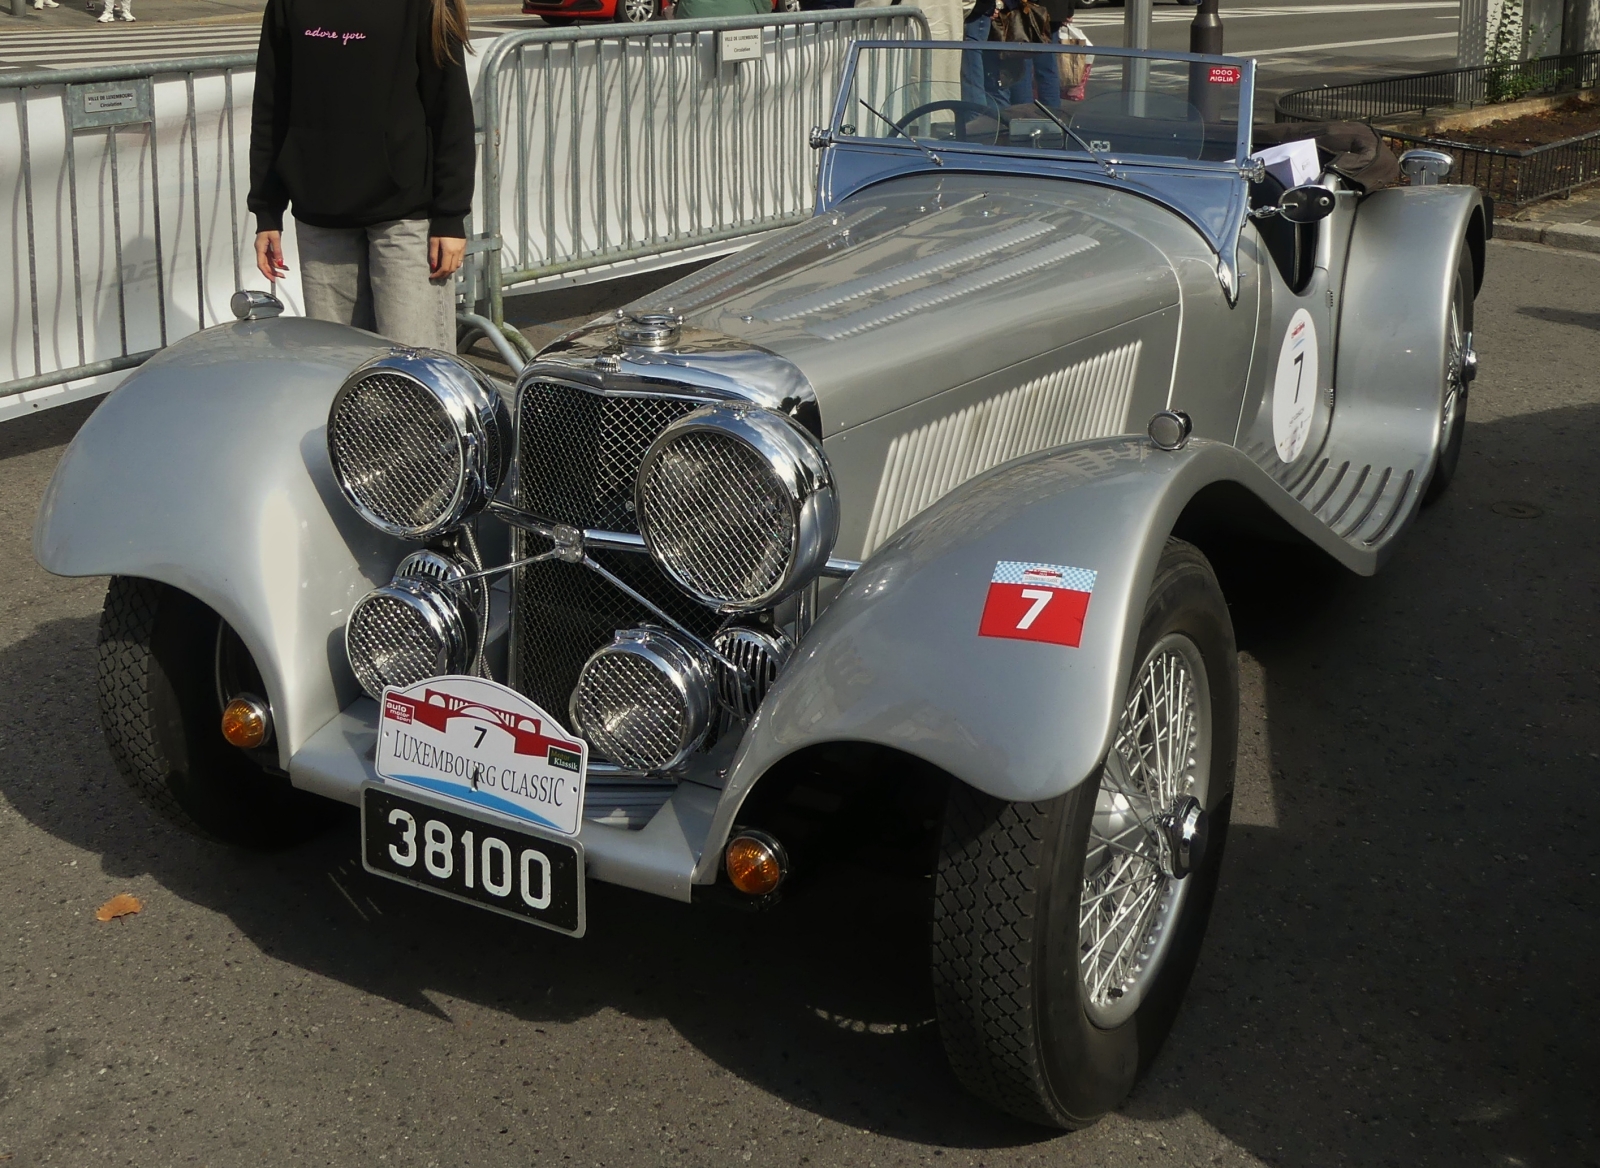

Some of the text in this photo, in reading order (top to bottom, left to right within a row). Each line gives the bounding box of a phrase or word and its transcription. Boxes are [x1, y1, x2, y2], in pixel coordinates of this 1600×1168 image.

[304, 26, 367, 46] adore you
[106, 92, 134, 100] LUXEMBOURG
[1293, 351, 1304, 405] 7
[1016, 588, 1054, 630] 7
[386, 701, 407, 713] auto
[389, 709, 410, 719] motor
[396, 715, 411, 724] sport
[473, 726, 488, 749] 7
[551, 750, 570, 761] Motor
[553, 757, 578, 771] Klassik
[393, 729, 565, 807] LUXEMBOURG CLASSIC
[388, 808, 552, 910] 38100
